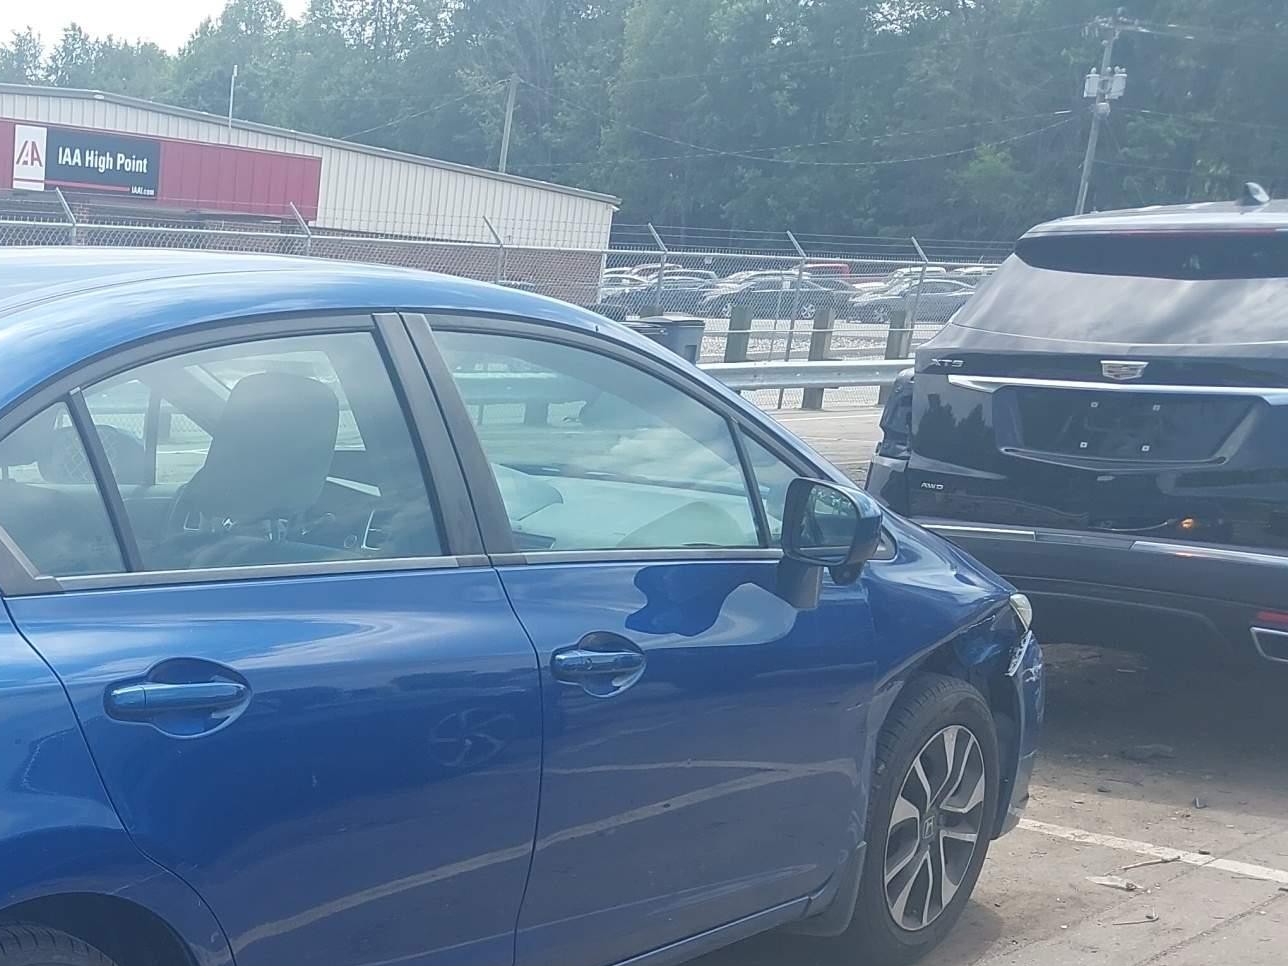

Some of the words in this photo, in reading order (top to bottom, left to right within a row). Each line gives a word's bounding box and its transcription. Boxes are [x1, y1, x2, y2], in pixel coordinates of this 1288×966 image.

[58, 146, 82, 167] IAA
[85, 151, 113, 173] High
[116, 153, 148, 174] Point
[921, 482, 944, 490] AWD
